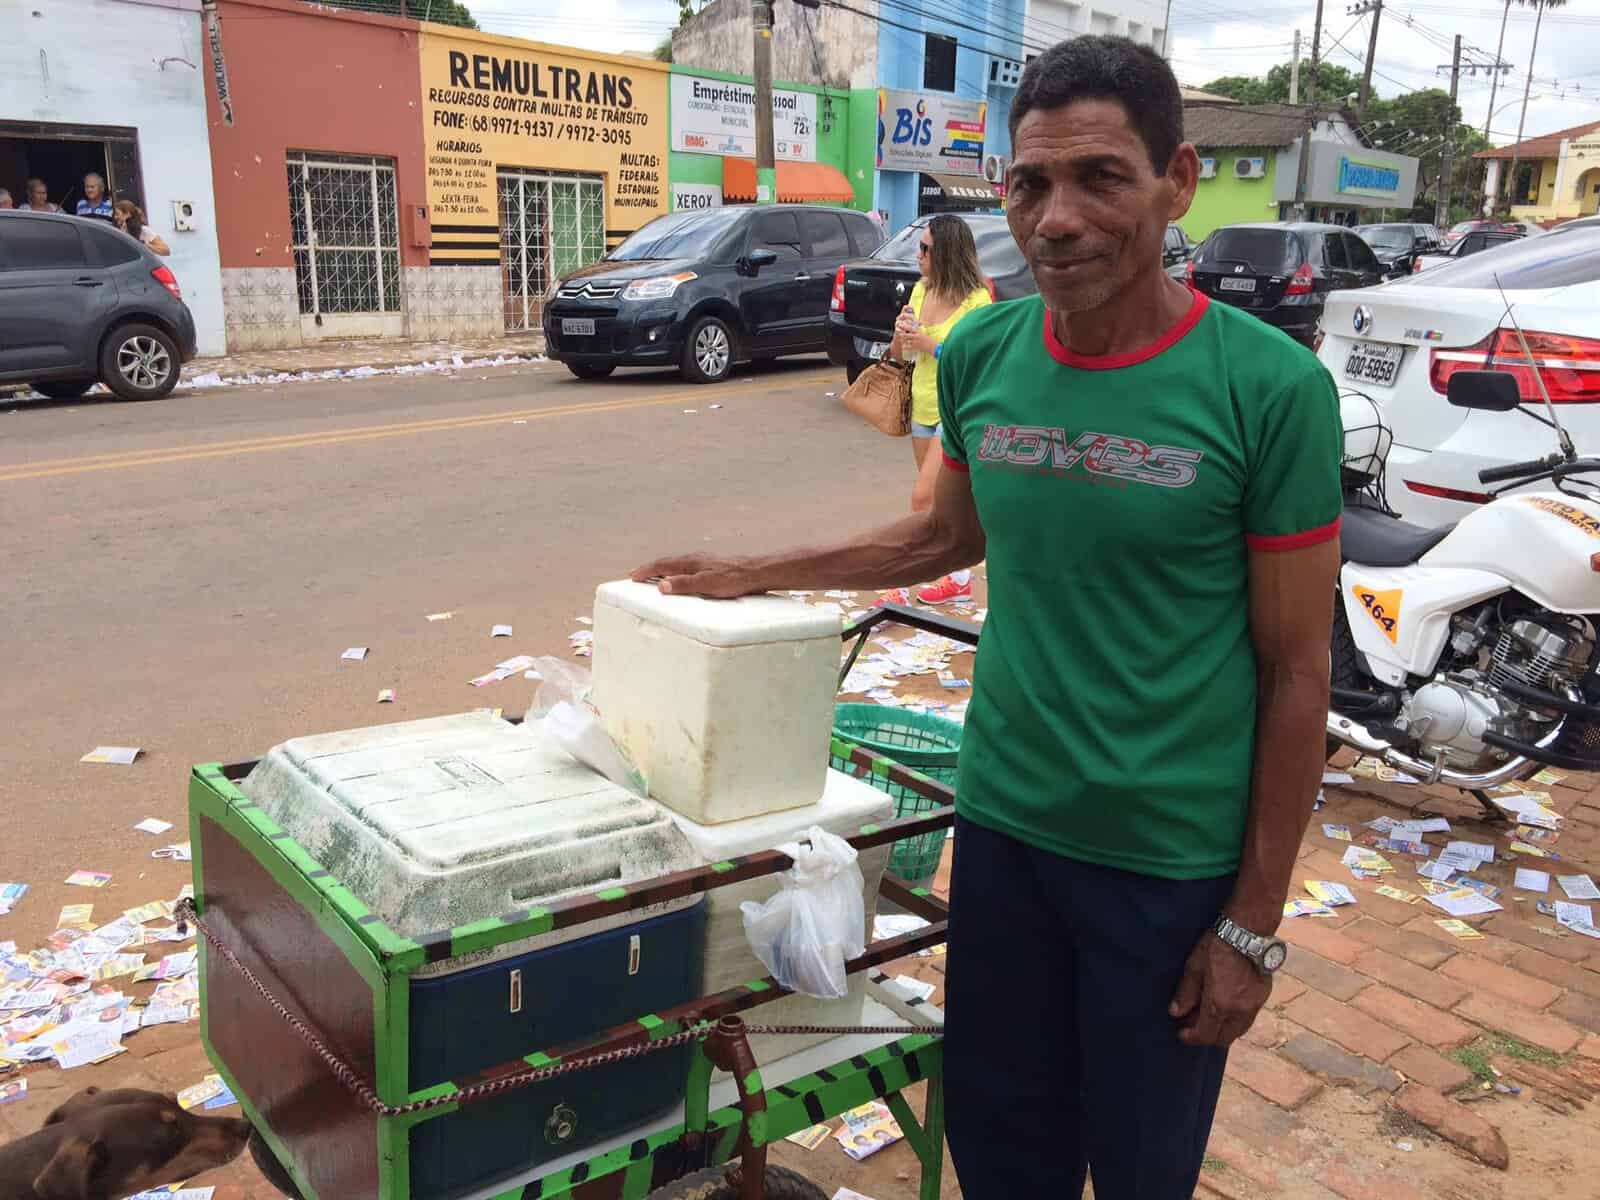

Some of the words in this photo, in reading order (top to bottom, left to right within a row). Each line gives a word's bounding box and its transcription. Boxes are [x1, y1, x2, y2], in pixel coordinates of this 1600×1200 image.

[449, 51, 633, 109] REMULTRANS
[429, 87, 490, 108] RECURSOS
[493, 96, 536, 114] CONTRA
[541, 102, 583, 119] MULTAS
[586, 107, 598, 120] DE
[774, 94, 797, 110] ssoal
[566, 125, 632, 145] 9972-3095
[620, 152, 660, 167] MULTAS:
[620, 170, 659, 182] FEDERAIS
[617, 184, 660, 195] ESTADUAIS
[614, 198, 659, 208] MUNICIPAIS
[676, 193, 713, 209] XEROX
[1361, 593, 1395, 632] 464
